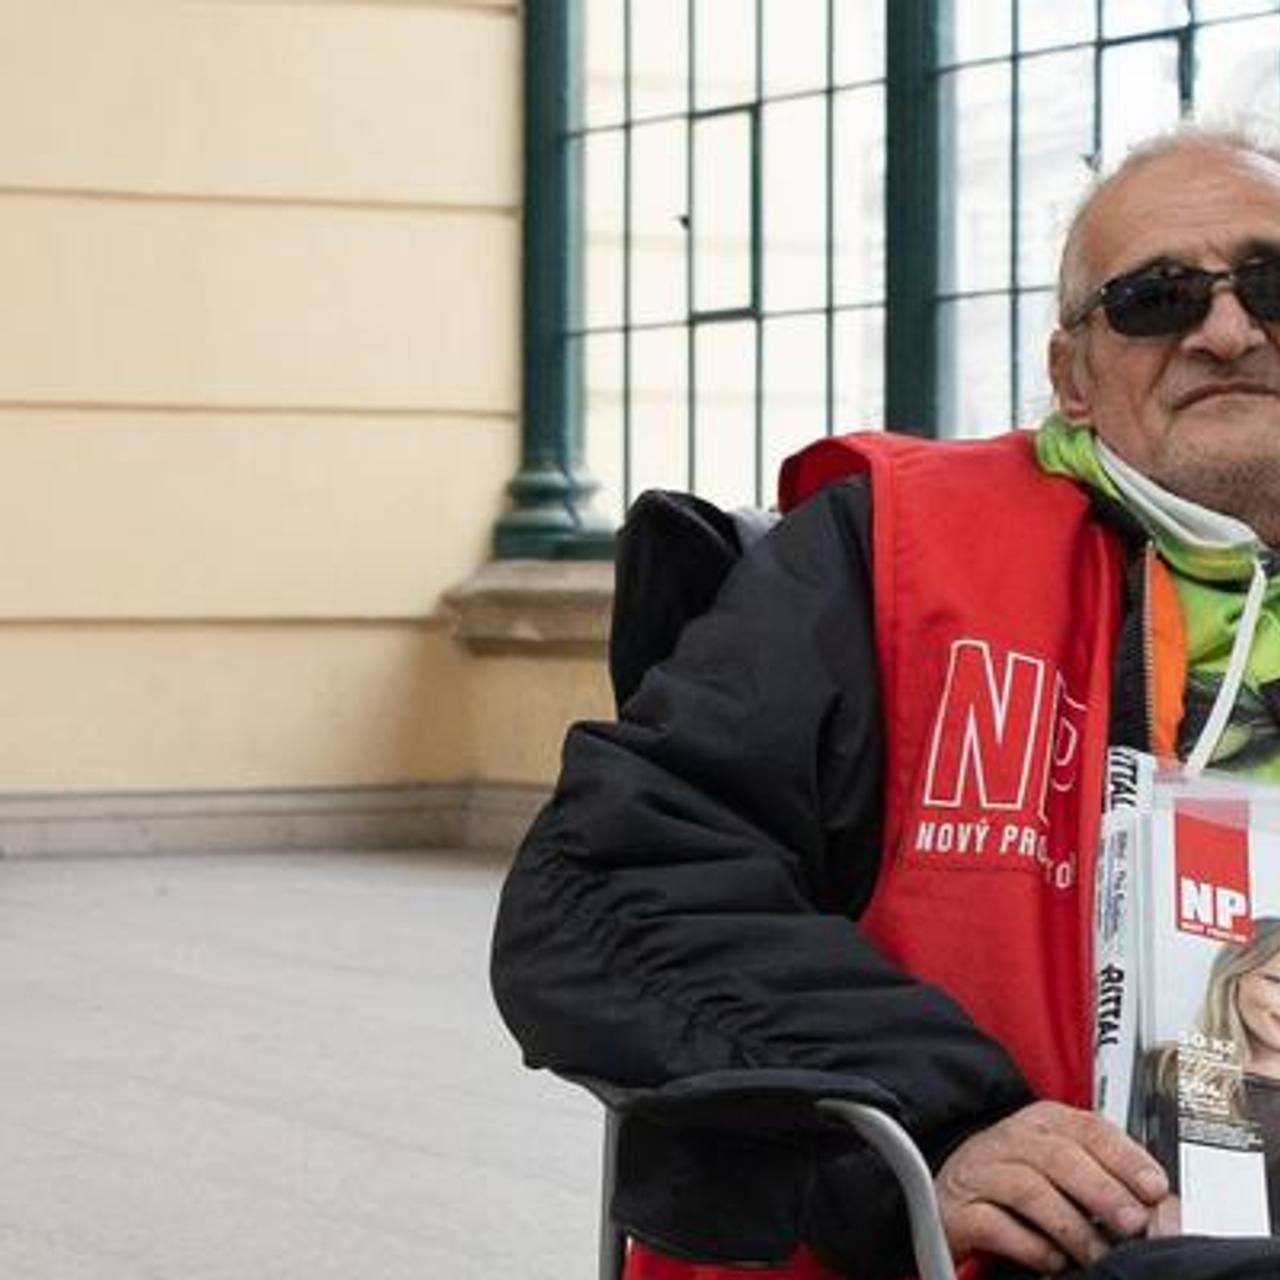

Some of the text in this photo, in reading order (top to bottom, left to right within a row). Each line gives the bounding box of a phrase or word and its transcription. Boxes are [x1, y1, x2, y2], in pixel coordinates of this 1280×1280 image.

[915, 817, 990, 852] NOVÝ
[1181, 879, 1247, 931] NP
[1098, 962, 1125, 1049] RITTAL
